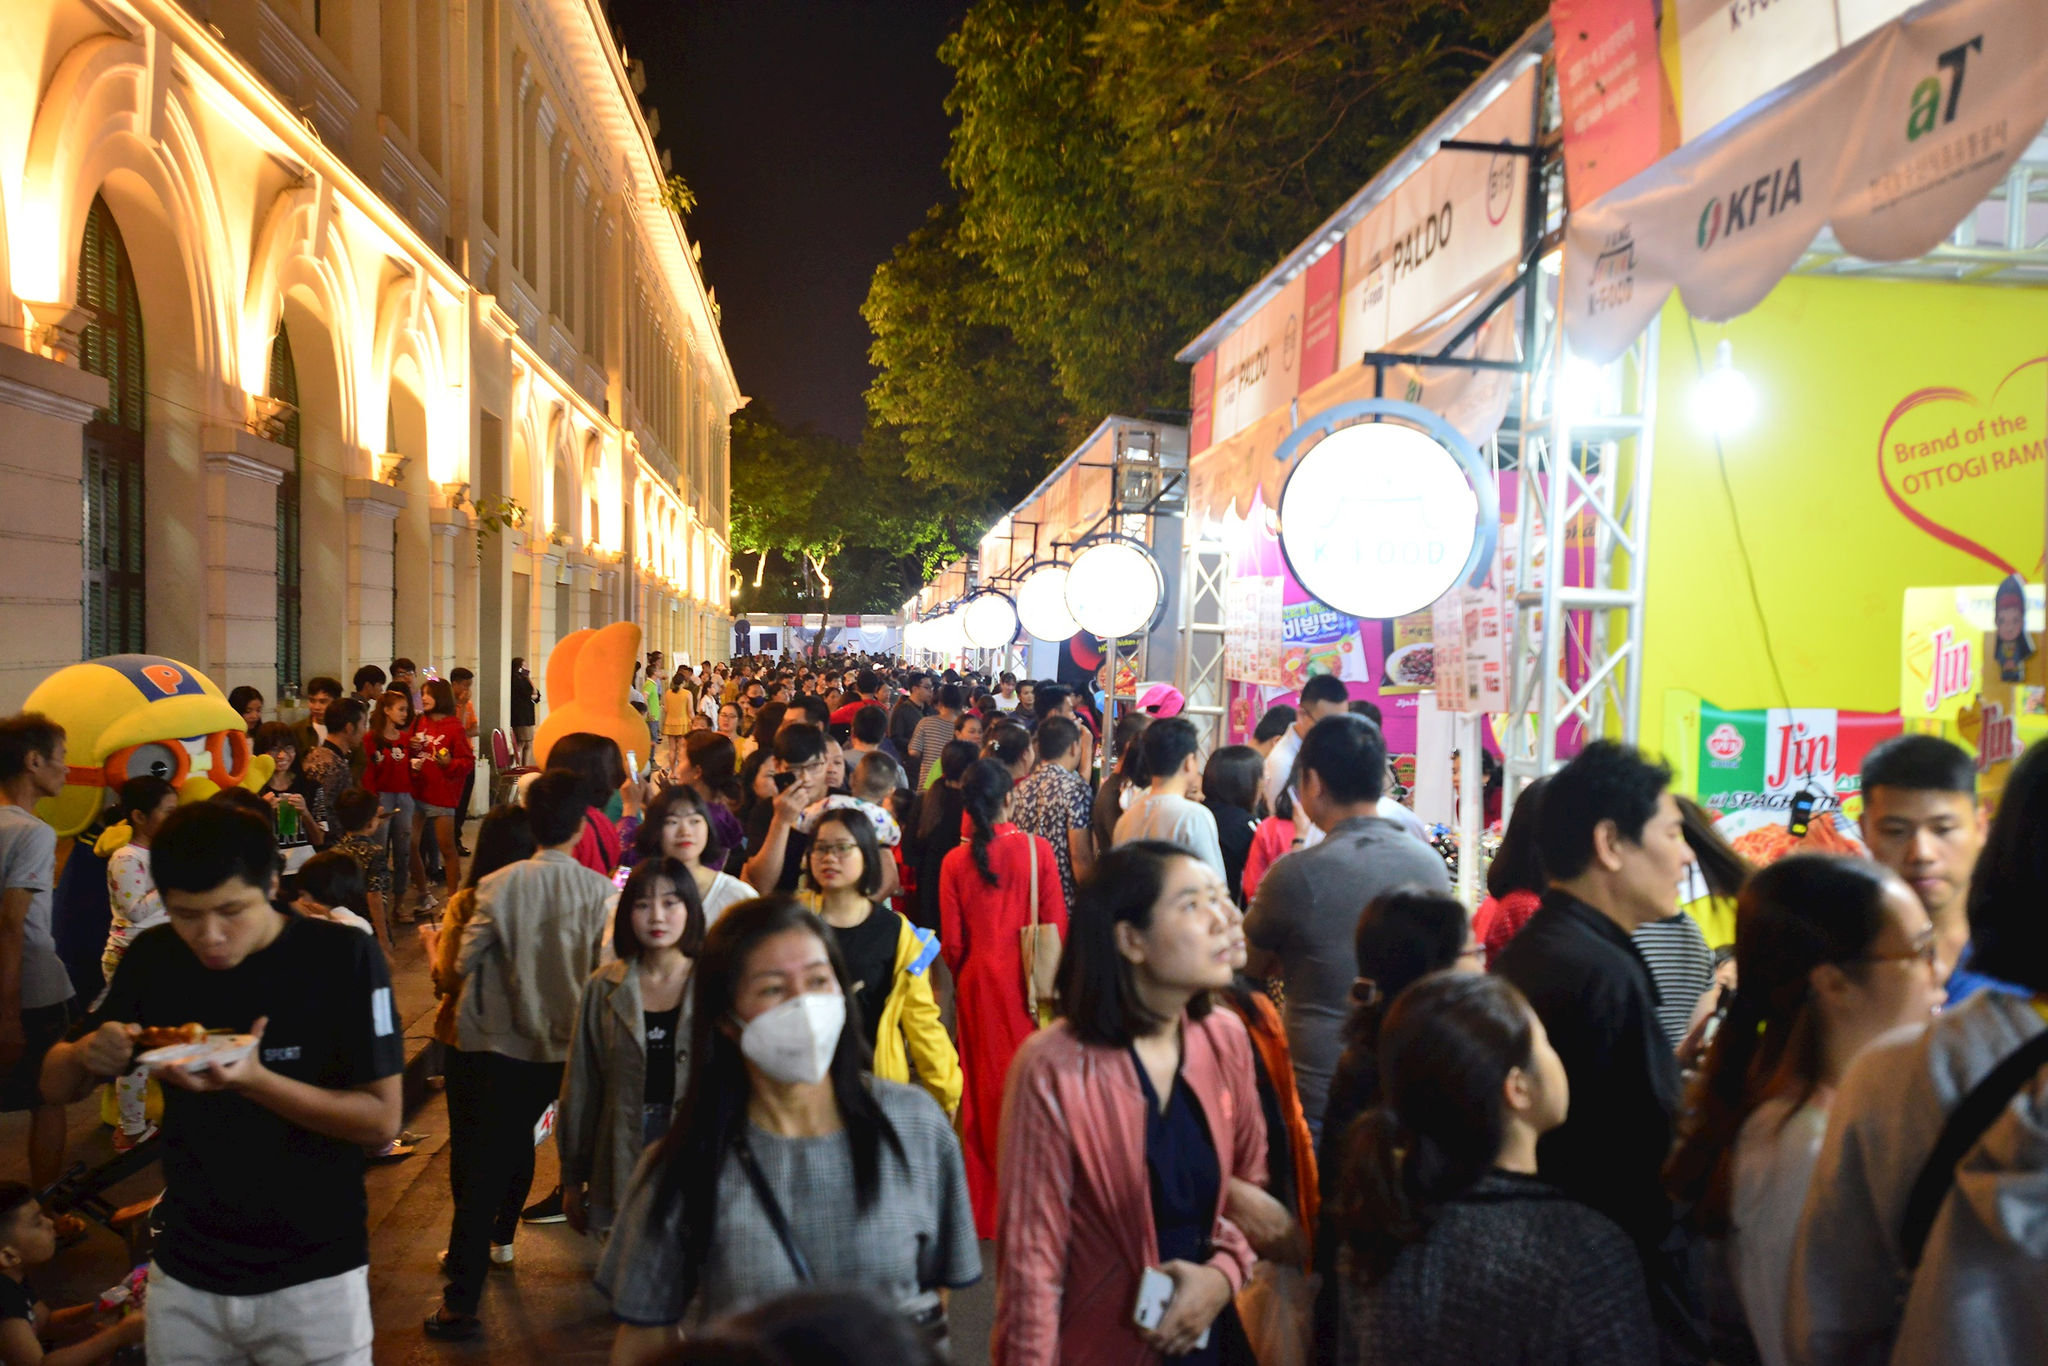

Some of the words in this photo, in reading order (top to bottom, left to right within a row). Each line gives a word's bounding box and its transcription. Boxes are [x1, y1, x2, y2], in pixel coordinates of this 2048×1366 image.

[1907, 34, 1984, 142] aT
[1724, 159, 1801, 238] KFIA
[1392, 201, 1452, 286] PALDO
[1239, 345, 1269, 392] PALDO
[1894, 427, 1960, 464] Brand
[1964, 419, 1987, 445] of
[1990, 415, 2028, 438] the
[1902, 455, 1989, 495] OTTOGI
[140, 664, 183, 695] P
[1925, 629, 1971, 709] Jin
[1767, 721, 1834, 788] Jin
